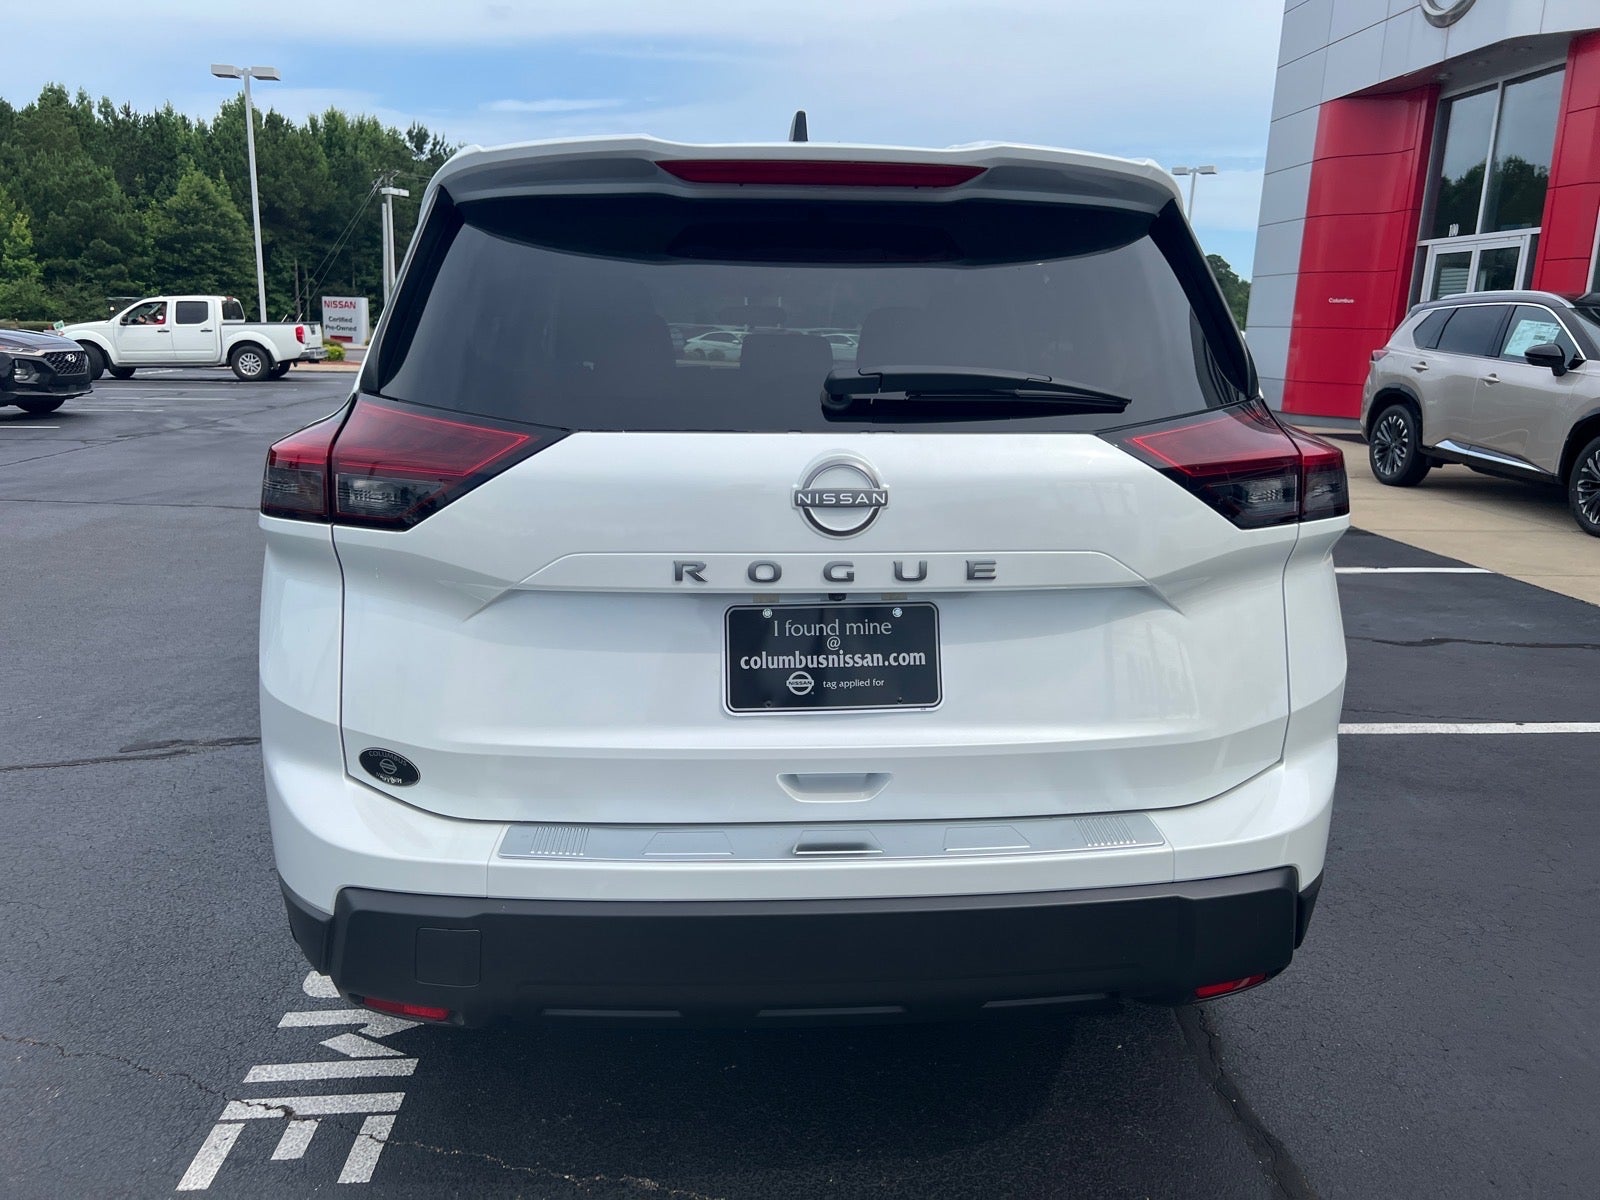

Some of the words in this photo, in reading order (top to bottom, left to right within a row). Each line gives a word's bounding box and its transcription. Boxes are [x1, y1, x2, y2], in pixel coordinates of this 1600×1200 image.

[324, 300, 356, 309] NISSAN
[797, 492, 887, 505] NISSAN
[673, 559, 997, 583] ROGUE
[773, 620, 779, 637] I
[785, 618, 840, 637] found
[845, 619, 893, 636] mine
[826, 635, 841, 651] @
[740, 650, 926, 669] columbusnissan.com
[822, 680, 837, 689] tag
[838, 678, 871, 689] applied
[872, 677, 886, 687] for
